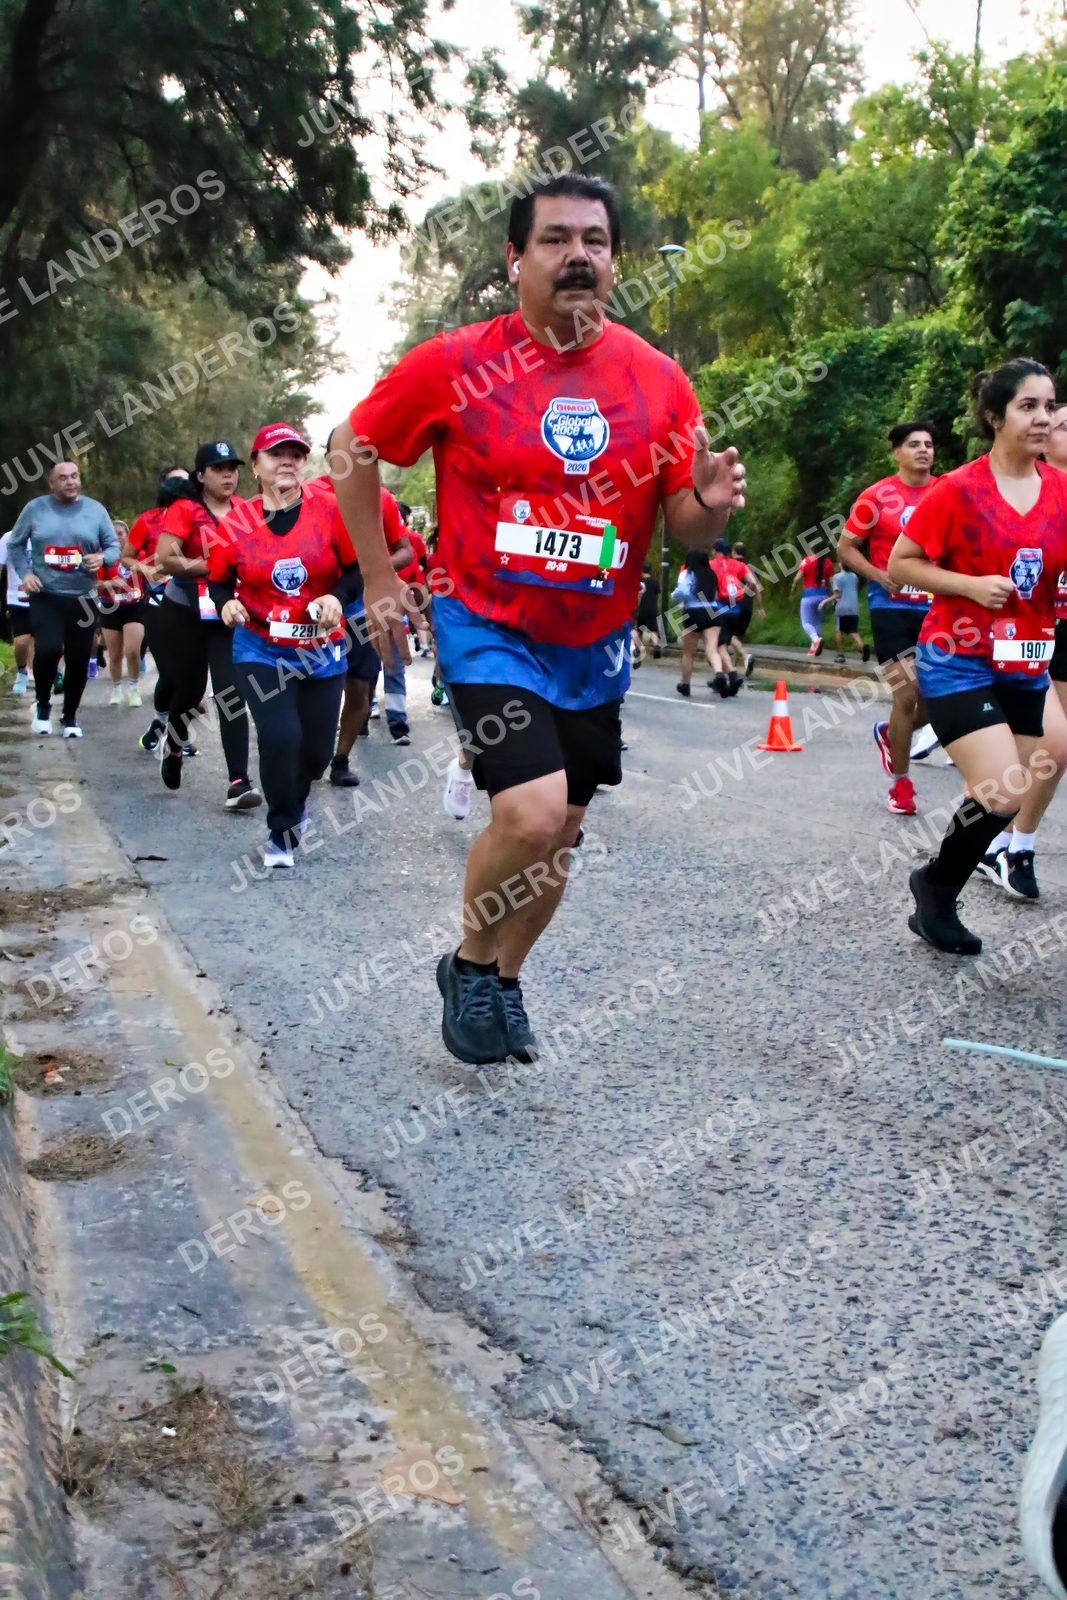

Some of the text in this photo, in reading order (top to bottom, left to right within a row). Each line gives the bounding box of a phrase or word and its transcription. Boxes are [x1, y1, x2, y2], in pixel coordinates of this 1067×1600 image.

[558, 415, 592, 427] Global
[552, 424, 580, 436] Race
[566, 463, 588, 472] 2026
[535, 530, 582, 560] 1473
[291, 624, 318, 638] 2291
[1020, 642, 1047, 659] 1907
